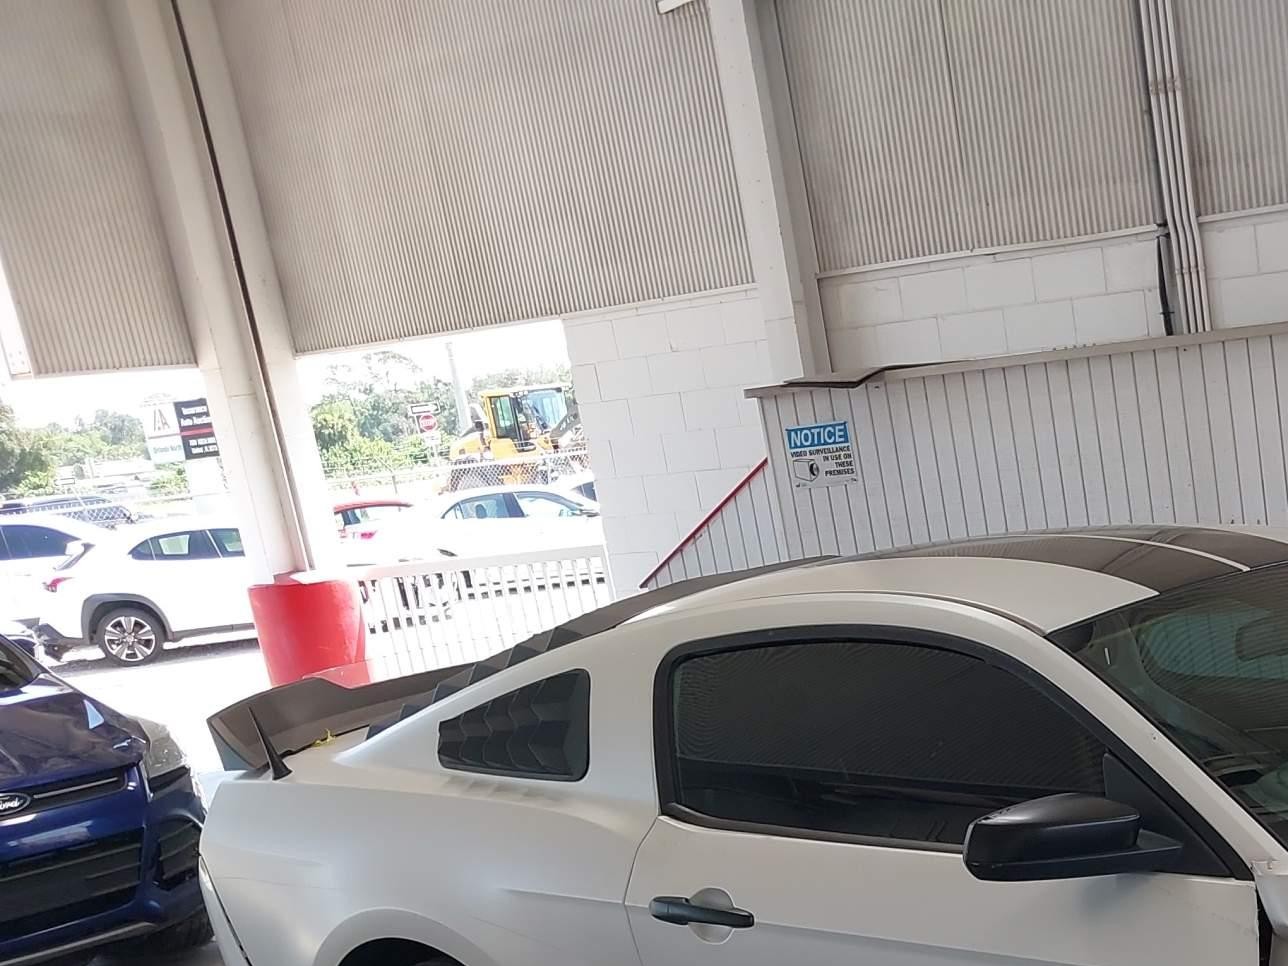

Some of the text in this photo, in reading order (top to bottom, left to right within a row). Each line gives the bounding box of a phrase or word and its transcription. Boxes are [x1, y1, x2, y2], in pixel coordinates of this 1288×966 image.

[790, 425, 845, 447] NOTICE
[791, 445, 851, 458] VIDEO SURVEILLANCE
[835, 460, 853, 468] THESE
[825, 468, 854, 476] PREMISES
